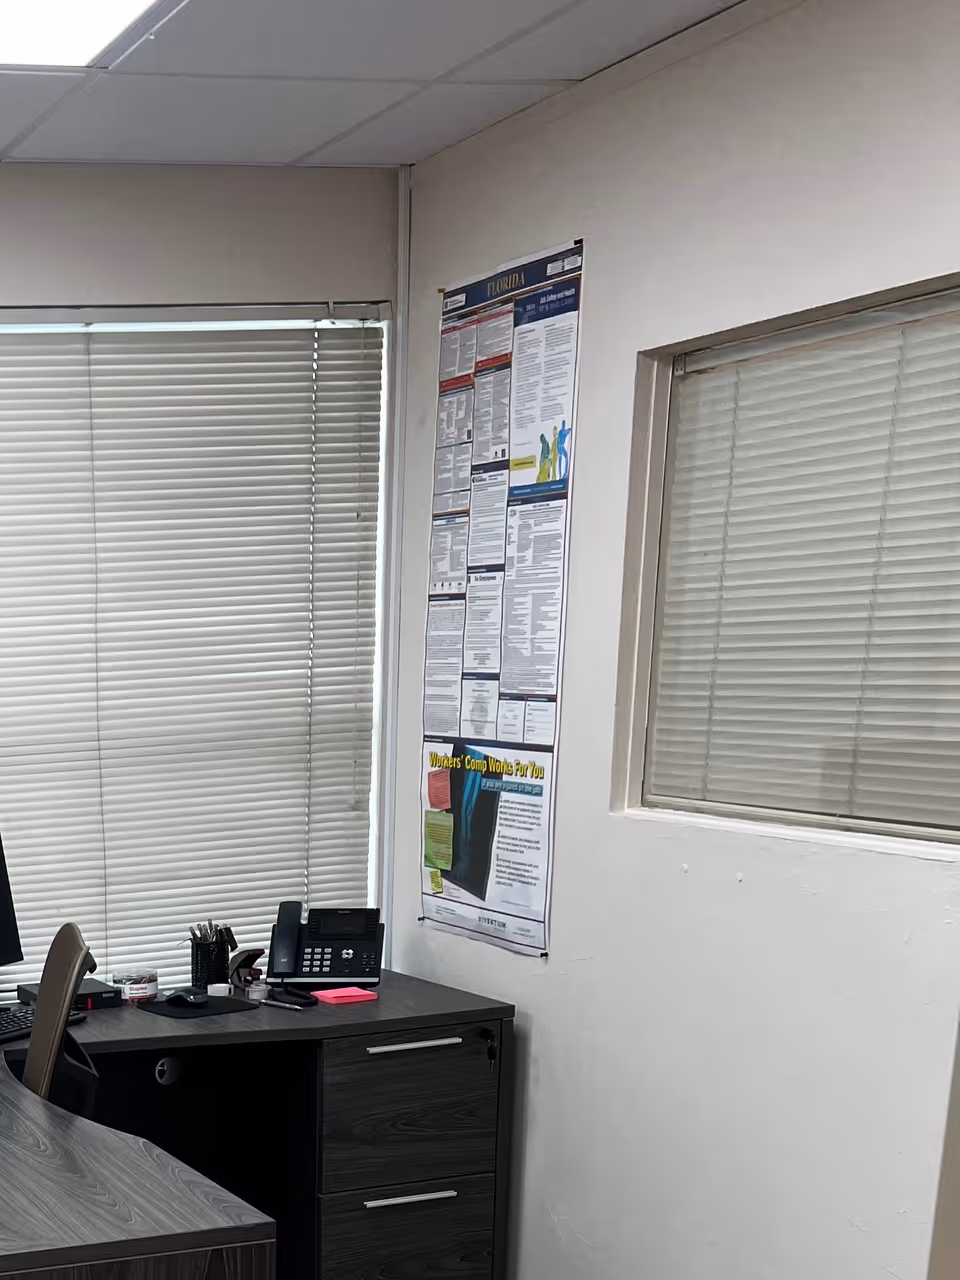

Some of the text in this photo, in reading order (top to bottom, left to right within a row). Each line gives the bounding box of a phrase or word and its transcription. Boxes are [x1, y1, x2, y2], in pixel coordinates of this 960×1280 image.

[487, 271, 525, 298] FLORIDA
[429, 751, 545, 780] Workers' Comp Works For You
